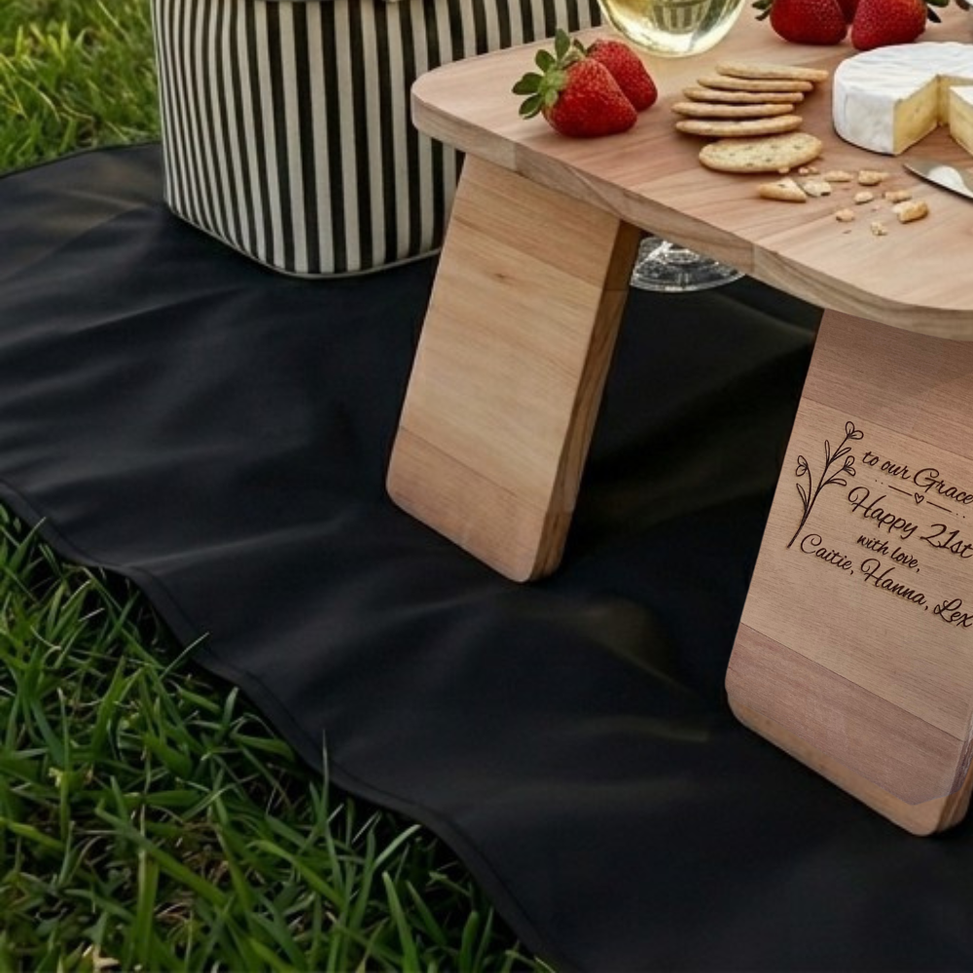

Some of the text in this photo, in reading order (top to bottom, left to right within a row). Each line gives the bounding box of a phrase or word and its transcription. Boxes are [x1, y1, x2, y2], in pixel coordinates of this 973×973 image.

[861, 450, 880, 467] to
[880, 460, 911, 481] our
[847, 486, 918, 540] Happy
[800, 533, 854, 576] Caitie,
[860, 557, 929, 612] Hanna,
[857, 534, 921, 574] with love,
